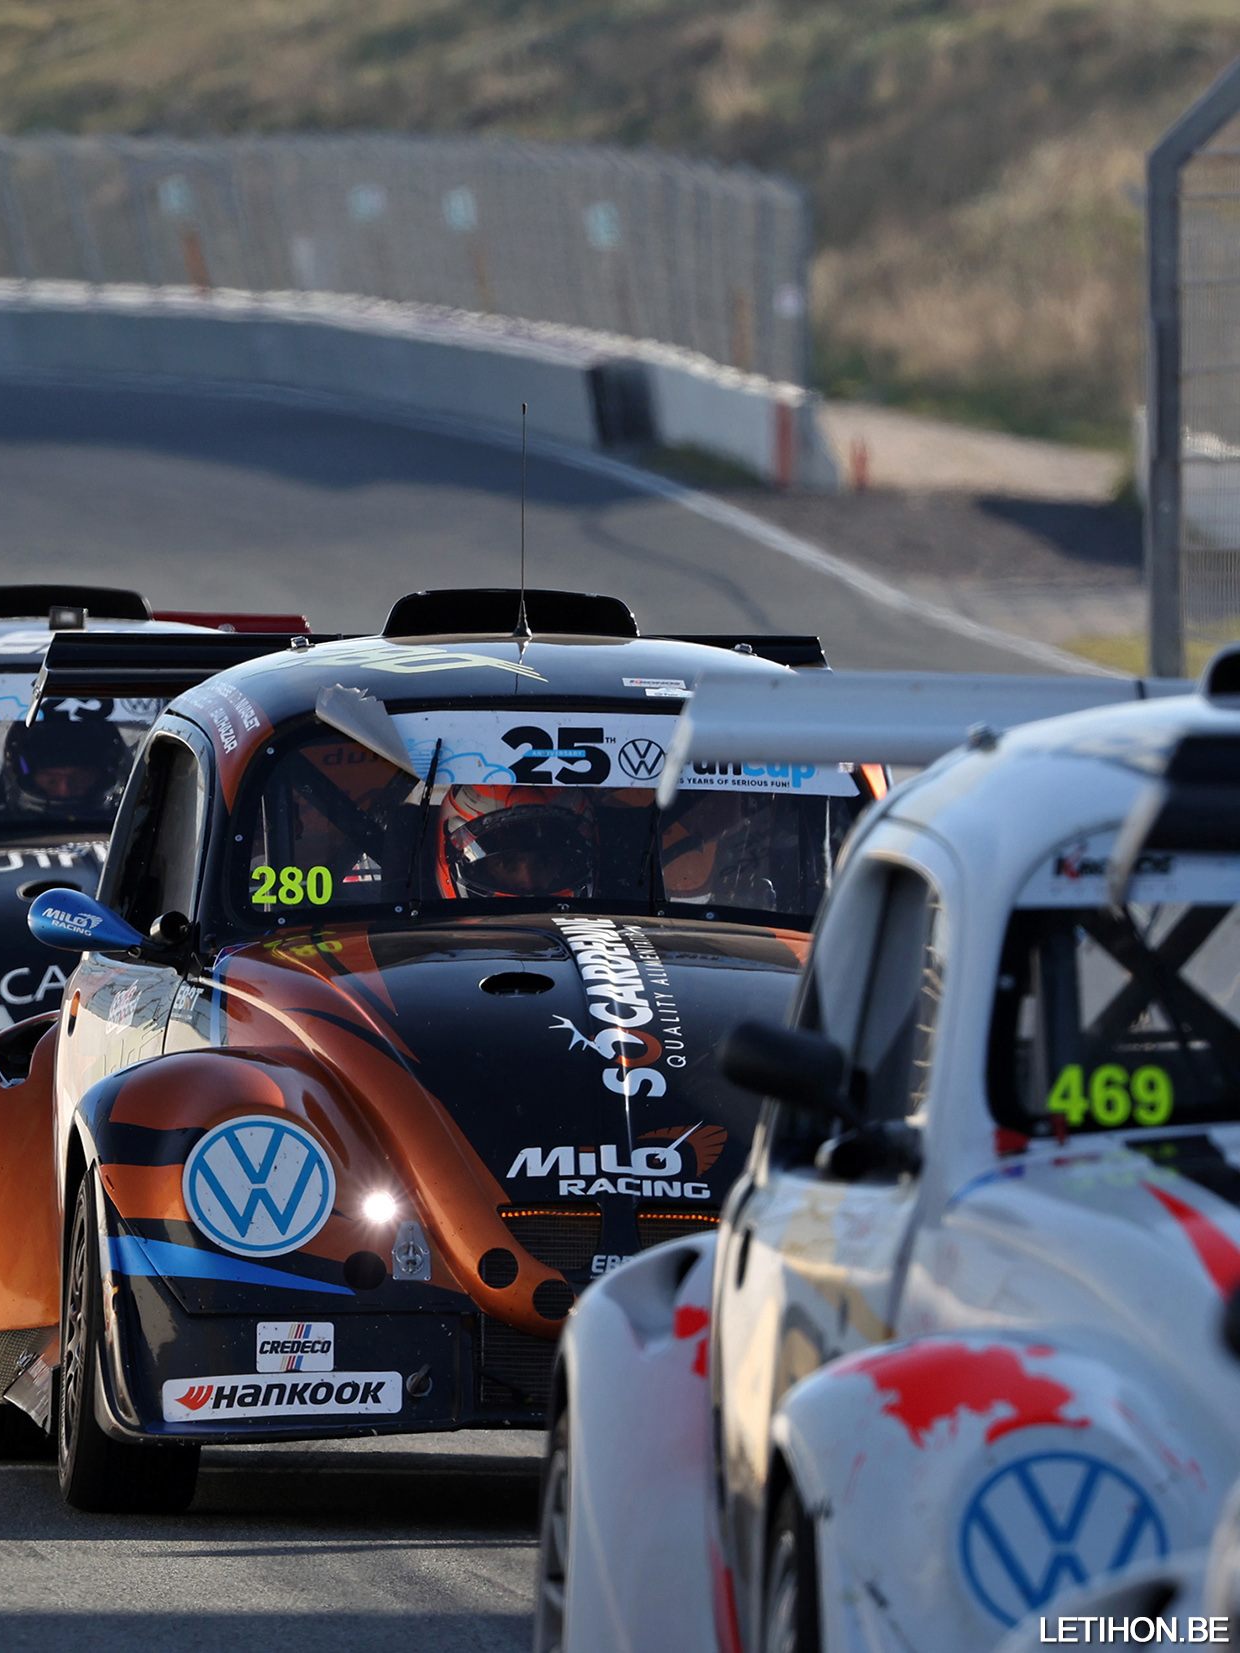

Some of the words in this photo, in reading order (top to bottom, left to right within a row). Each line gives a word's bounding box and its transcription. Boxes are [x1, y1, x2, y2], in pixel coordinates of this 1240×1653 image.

[501, 726, 611, 784] 25
[251, 866, 332, 905] 280
[51, 919, 92, 936] RACING
[653, 991, 687, 1068] QUALITY
[1047, 1064, 1173, 1127] 469
[559, 1177, 711, 1199] RACING
[259, 1339, 331, 1356] CREDECO
